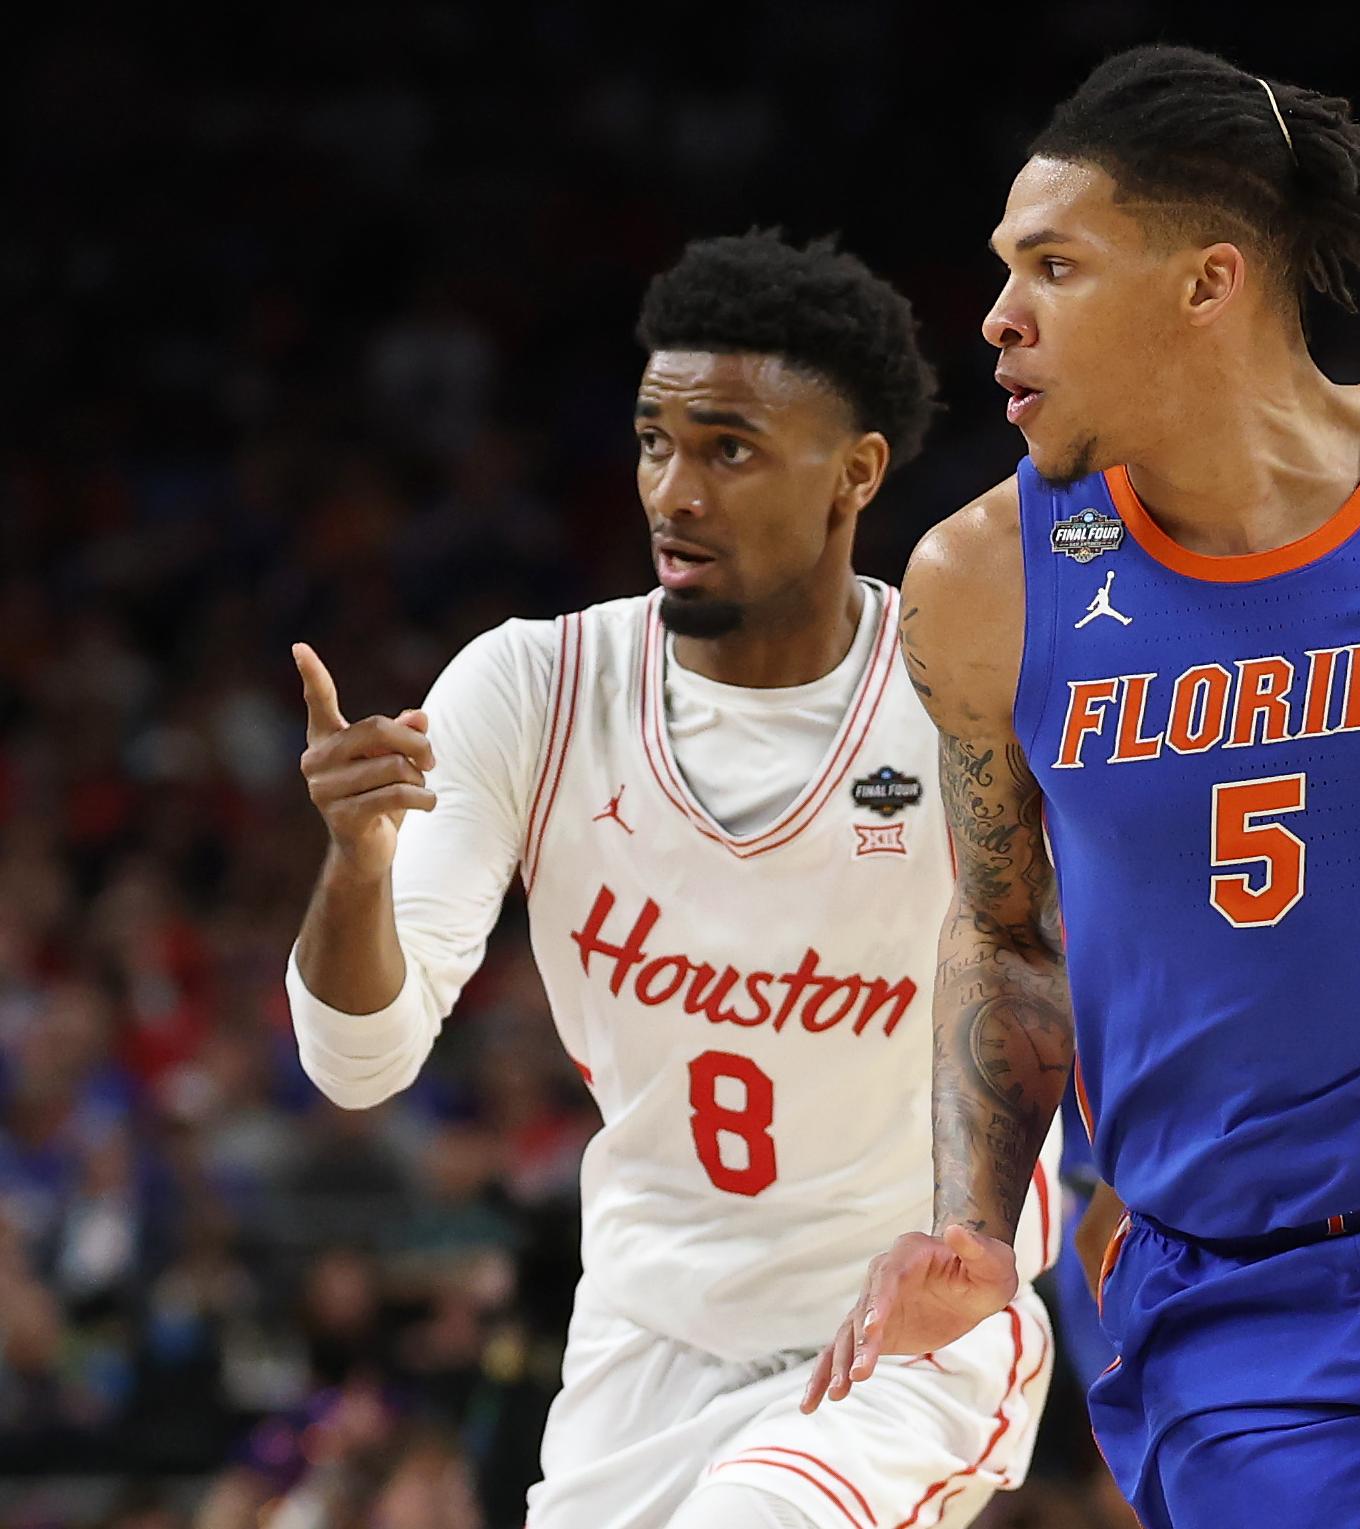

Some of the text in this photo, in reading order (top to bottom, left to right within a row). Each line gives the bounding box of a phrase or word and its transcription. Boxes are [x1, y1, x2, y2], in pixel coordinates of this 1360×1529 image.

[1055, 528, 1087, 541] FINAL
[1088, 526, 1120, 540] FOUR
[855, 782, 919, 799] FINAL FOUR
[1209, 772, 1306, 929] 5
[571, 884, 918, 1038] Houston
[688, 1050, 778, 1197] 8
